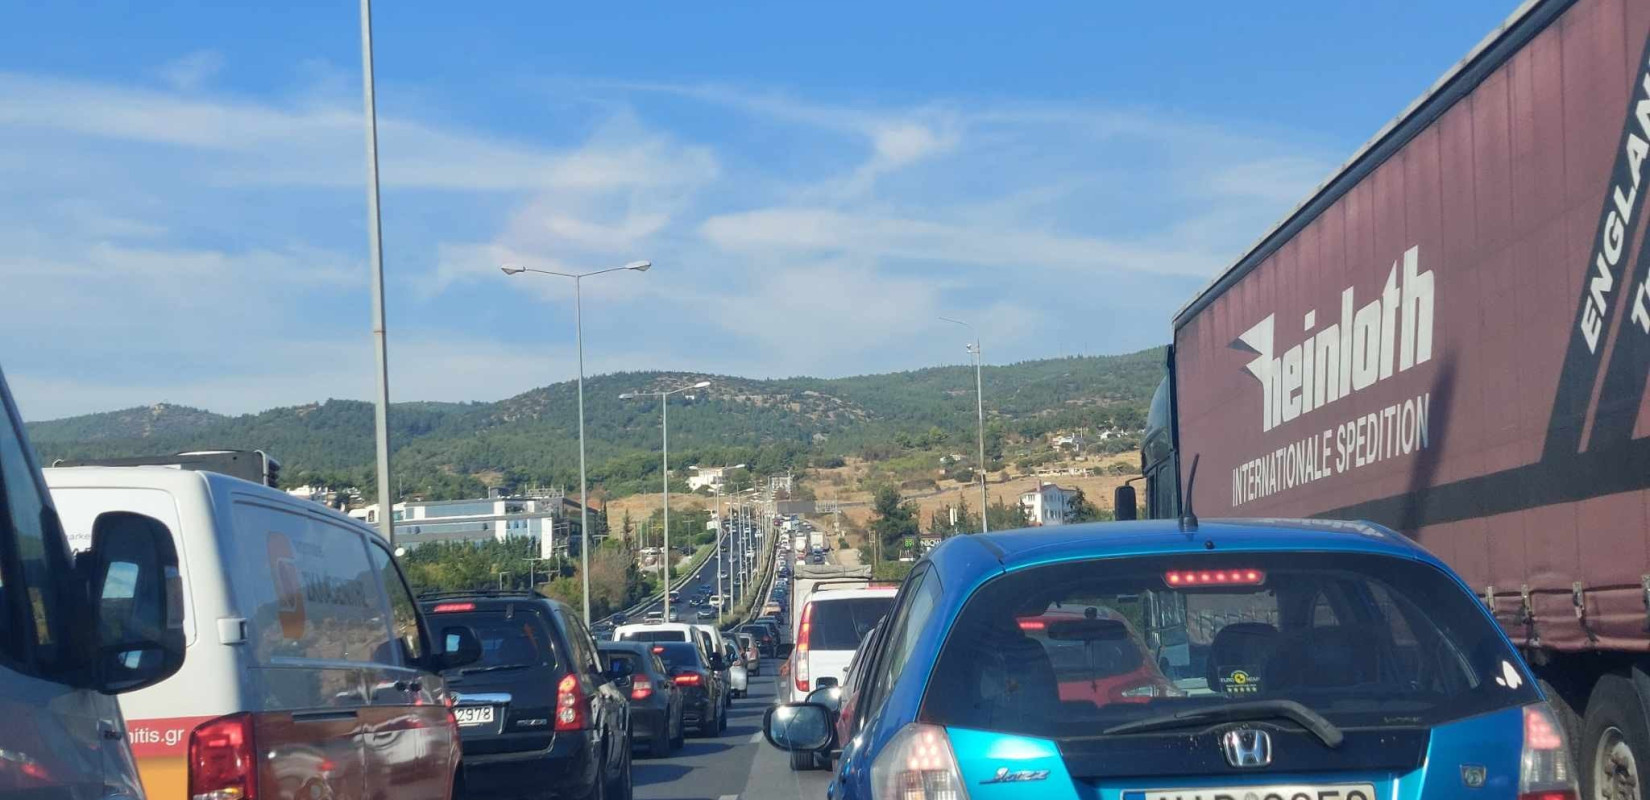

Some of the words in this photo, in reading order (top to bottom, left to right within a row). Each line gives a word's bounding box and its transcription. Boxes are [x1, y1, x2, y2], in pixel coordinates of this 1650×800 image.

[1581, 54, 1650, 354] ENGLAN
[1238, 245, 1434, 432] heinloth
[1232, 429, 1333, 508] INTERNATIONALE
[1336, 392, 1430, 474] SPEDITION
[458, 707, 491, 721] 2978
